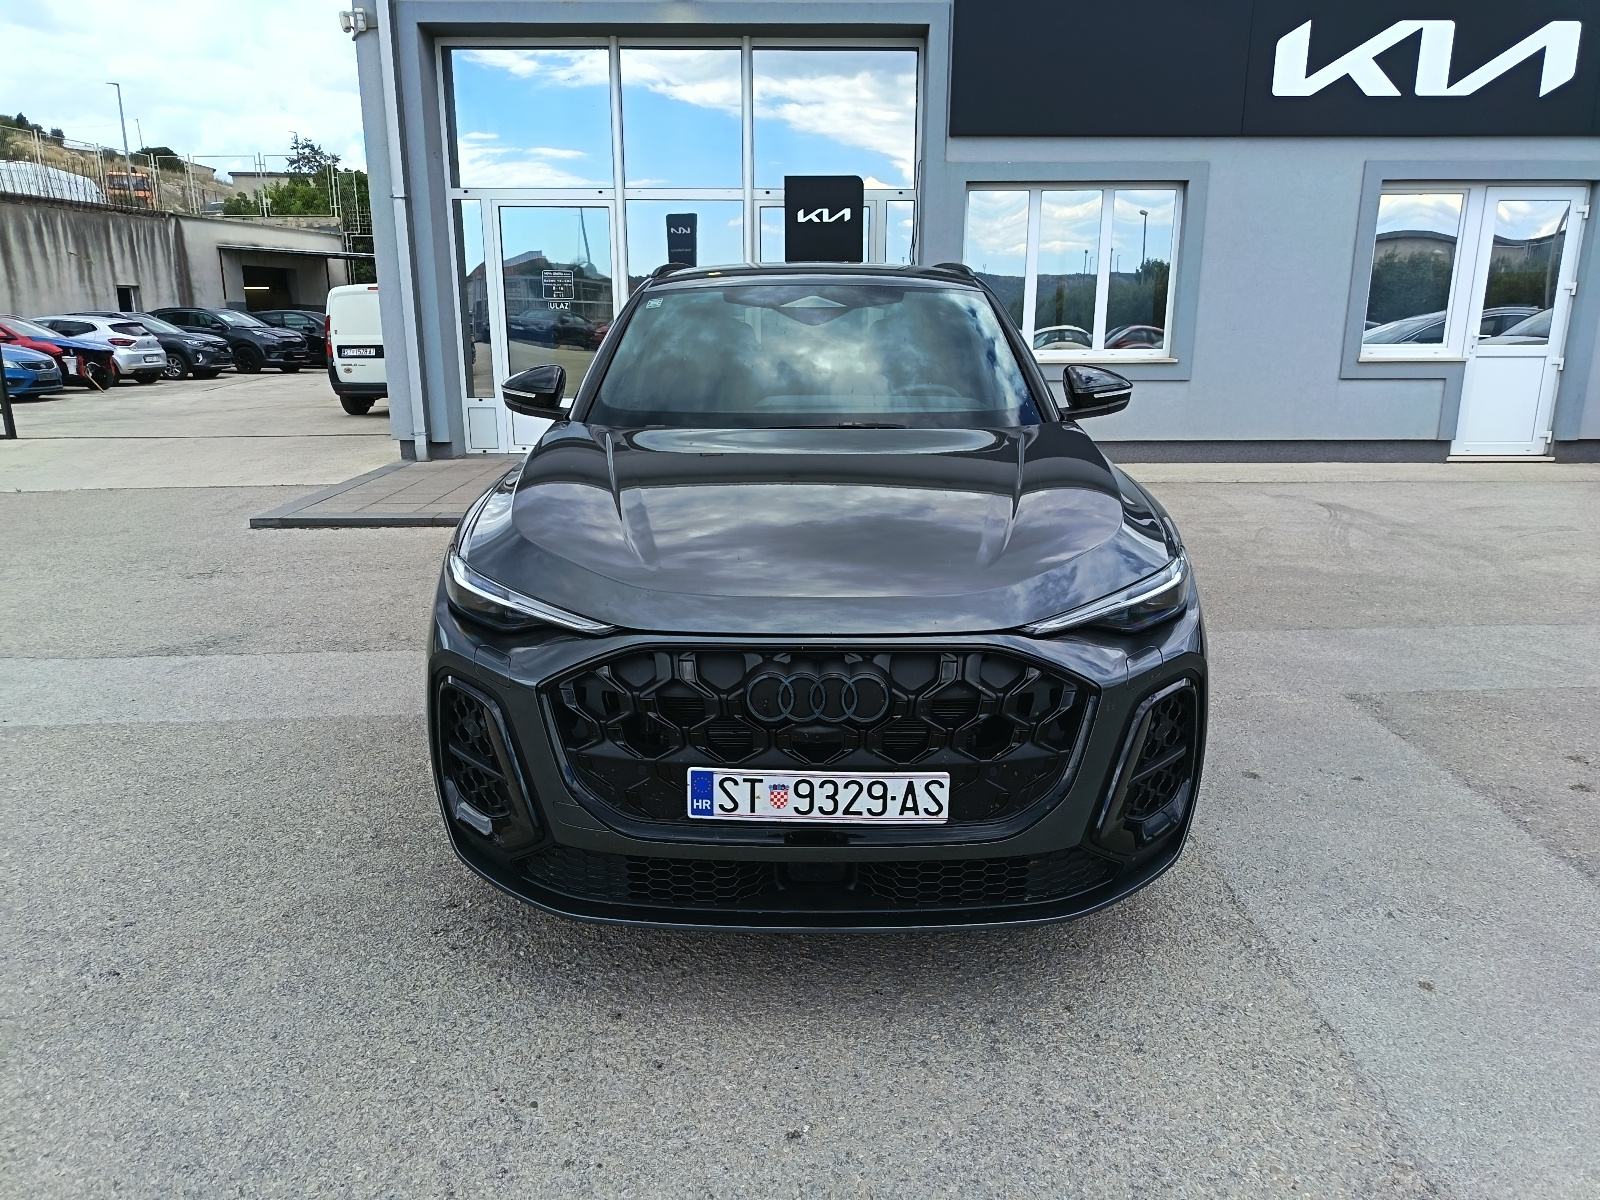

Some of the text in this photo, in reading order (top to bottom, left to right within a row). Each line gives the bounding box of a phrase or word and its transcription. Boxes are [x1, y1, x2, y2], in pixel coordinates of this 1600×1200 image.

[1272, 19, 1582, 98] KIA
[797, 207, 851, 223] KIA
[693, 800, 711, 810] HR
[718, 776, 763, 813] ST
